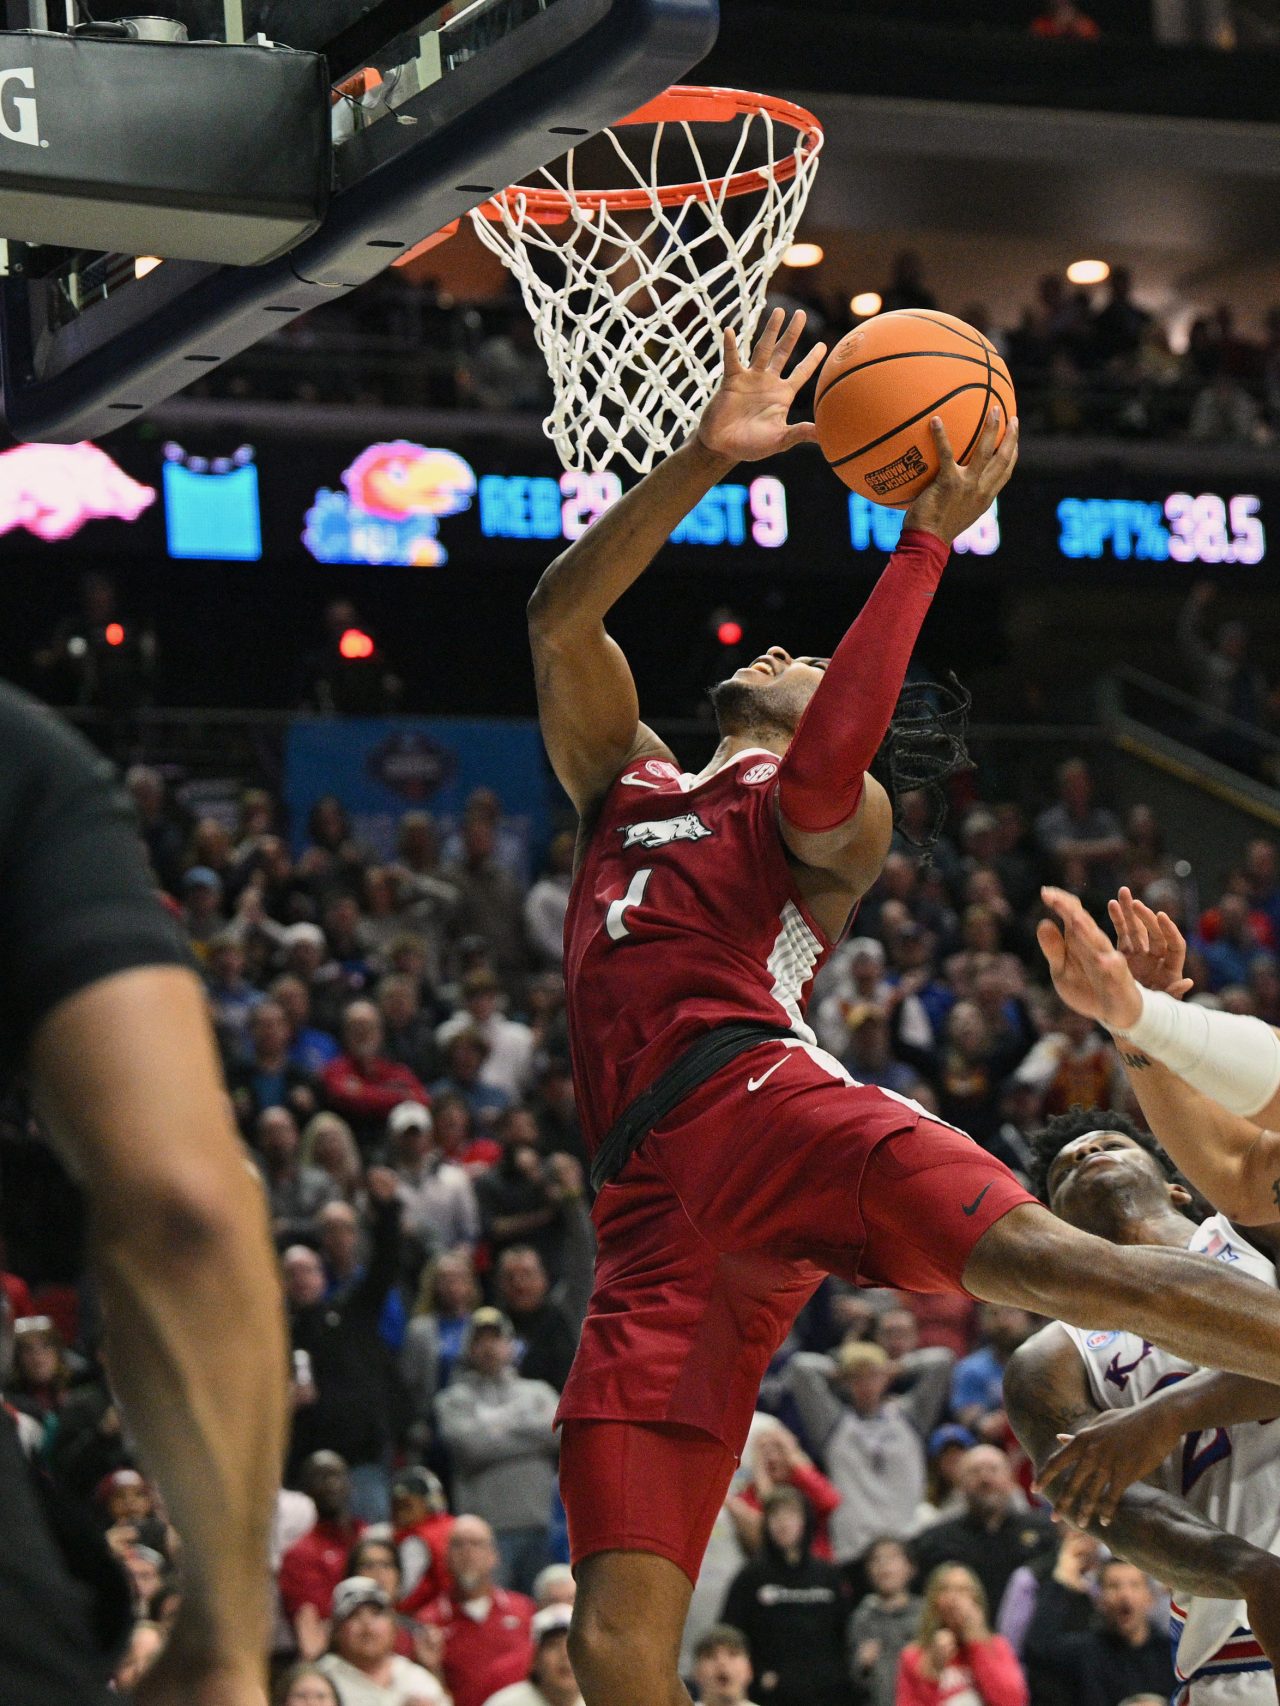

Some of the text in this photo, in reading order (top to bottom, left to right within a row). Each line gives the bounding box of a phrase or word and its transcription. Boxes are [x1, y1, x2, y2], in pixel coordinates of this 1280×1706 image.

[865, 461, 907, 486] MADNESS
[885, 466, 919, 490] MARCH
[750, 475, 788, 547] 9
[1164, 491, 1266, 565] 38.5
[604, 867, 653, 941] 1
